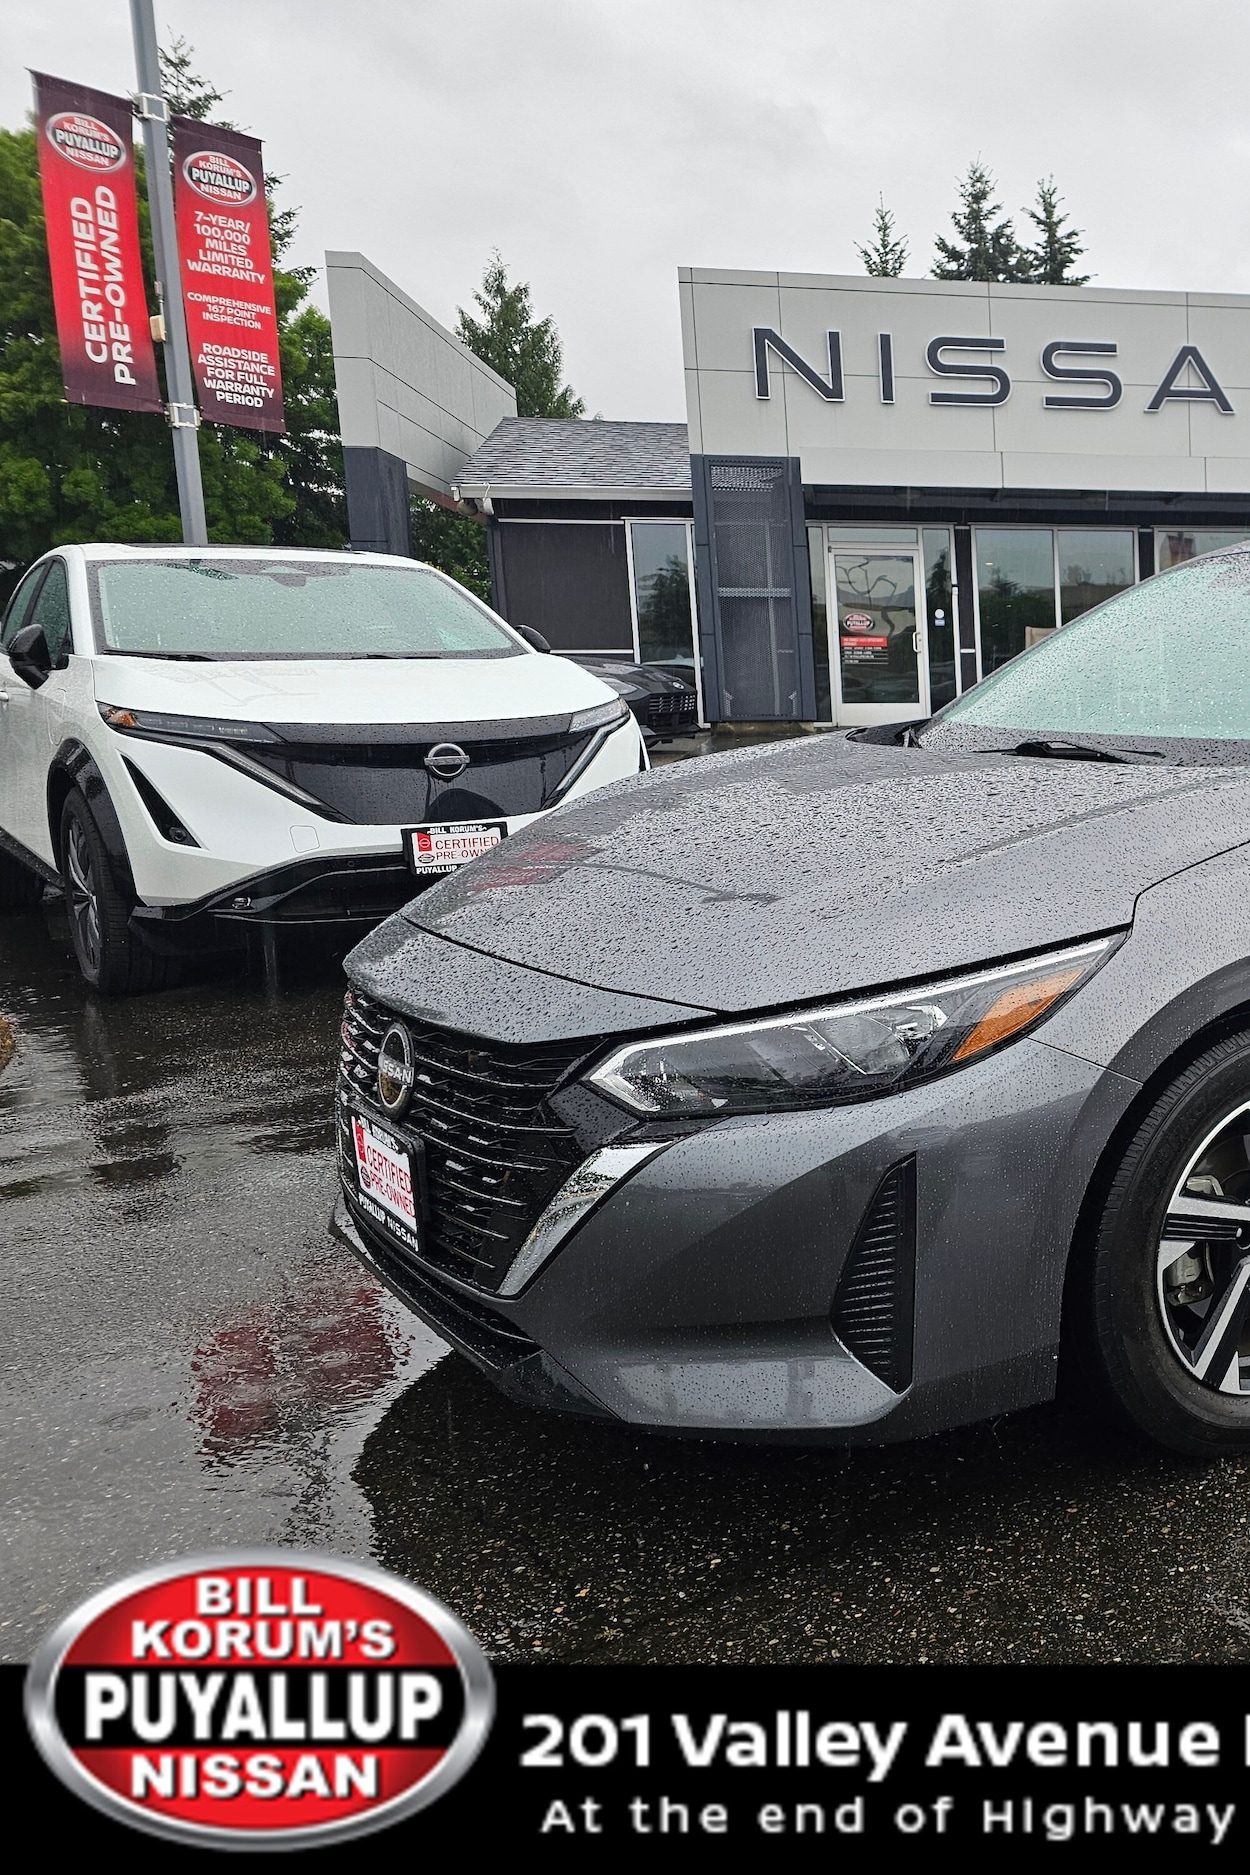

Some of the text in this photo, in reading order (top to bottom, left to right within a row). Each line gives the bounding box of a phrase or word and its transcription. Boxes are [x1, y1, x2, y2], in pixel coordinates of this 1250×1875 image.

[73, 116, 99, 131] BILL
[55, 128, 119, 158] PUYALLUP
[65, 146, 110, 167] NISSAN
[209, 155, 231, 168] BILL
[191, 167, 250, 193] PUYALLUP
[198, 160, 242, 178] KORUM'S
[200, 183, 242, 201] NISSAN
[194, 210, 251, 233] 7-YEAR/
[194, 223, 251, 246] 100,000
[205, 237, 248, 257] MILES
[198, 249, 254, 271] LIMITED
[70, 196, 109, 364] CERTIFIED
[186, 259, 266, 285] WARRANTY
[95, 185, 137, 386] PRE-OWNED
[187, 291, 272, 316] COMPREHENSIVE
[206, 303, 257, 321] 167 POINT
[202, 311, 263, 330] INSPECTION
[202, 342, 269, 364] ROADSIDE
[197, 353, 276, 377] ASSISTANCE
[206, 366, 268, 387] FOR FULL
[203, 377, 275, 399] WARRANTY
[215, 391, 264, 408] PERIOD
[430, 826, 447, 835] BILL
[435, 836, 499, 850] CERTIFIED
[436, 848, 487, 861] PRE-OW
[416, 864, 458, 875] PUYALLUP
[366, 1144, 412, 1195] CERTIFIED
[369, 1170, 416, 1218] PRE-OWNED
[387, 1215, 419, 1252] NISSAN
